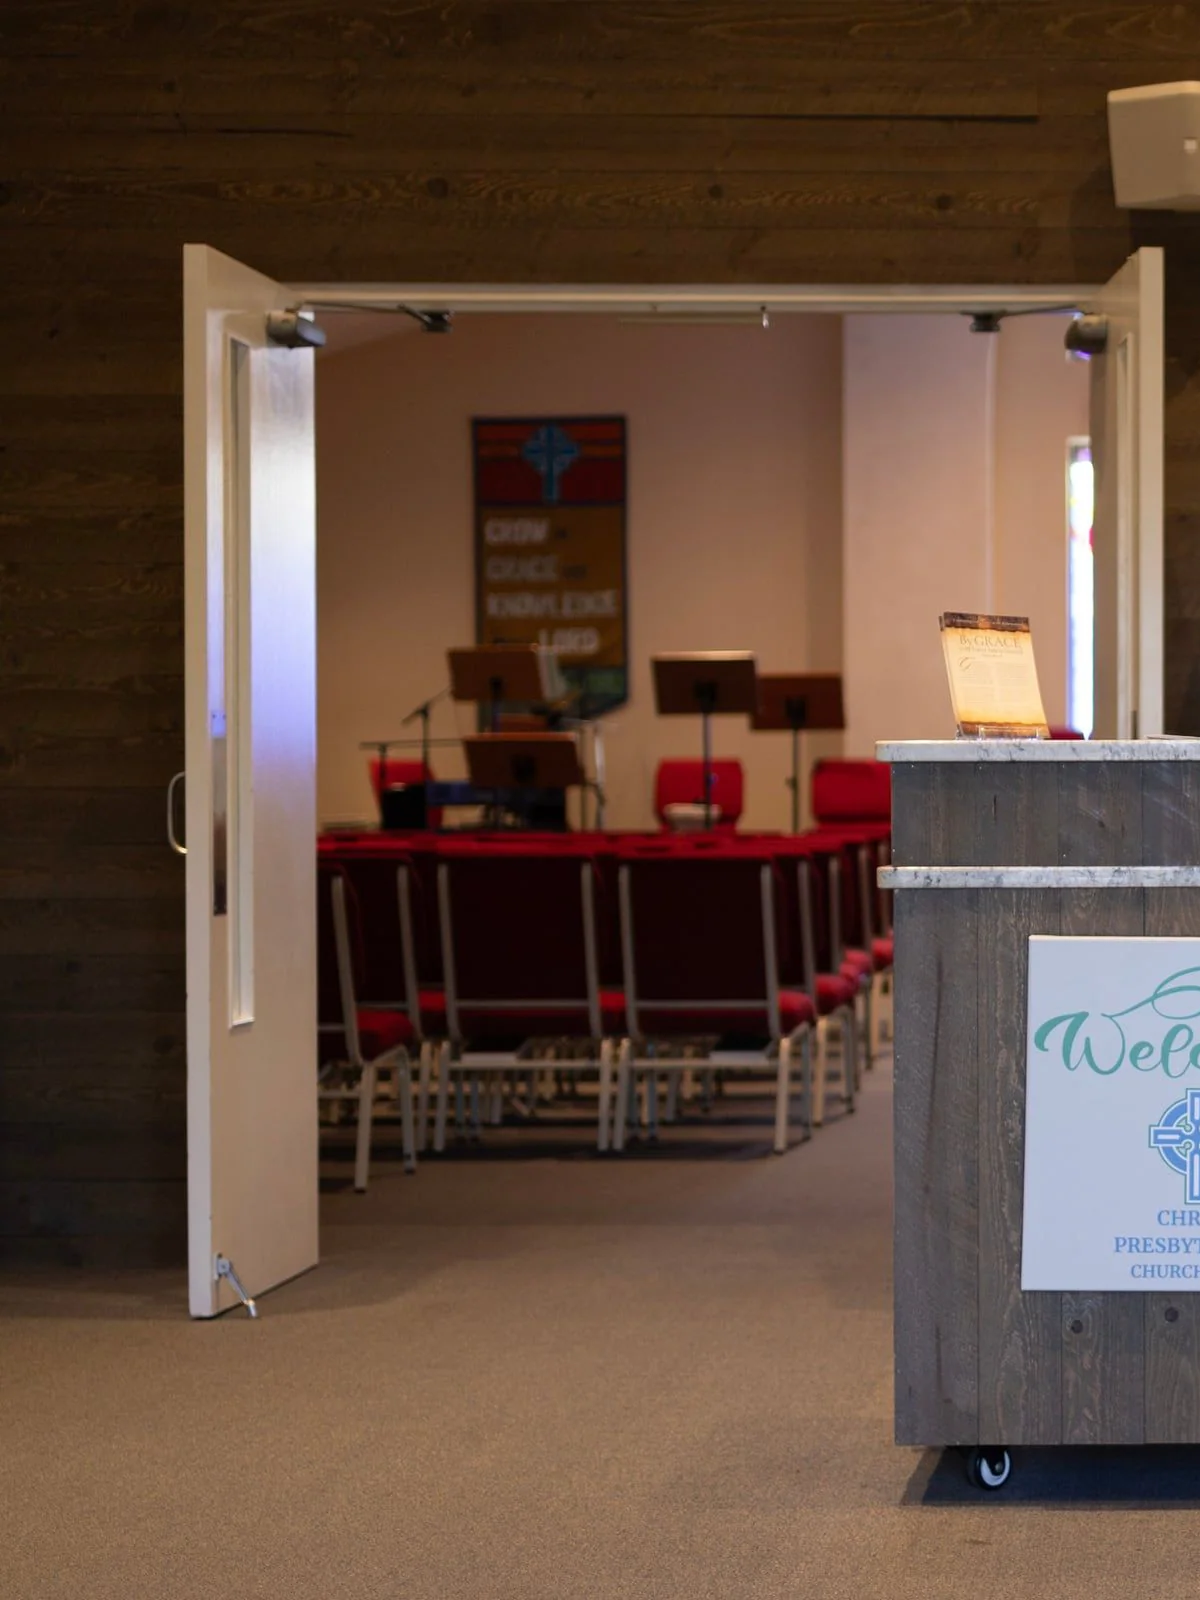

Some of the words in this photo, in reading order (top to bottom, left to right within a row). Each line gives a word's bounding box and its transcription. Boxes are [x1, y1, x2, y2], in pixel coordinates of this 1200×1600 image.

[487, 589, 618, 619] KNOWLEDGE
[537, 626, 601, 655] LORD
[974, 635, 1022, 648] GRACE
